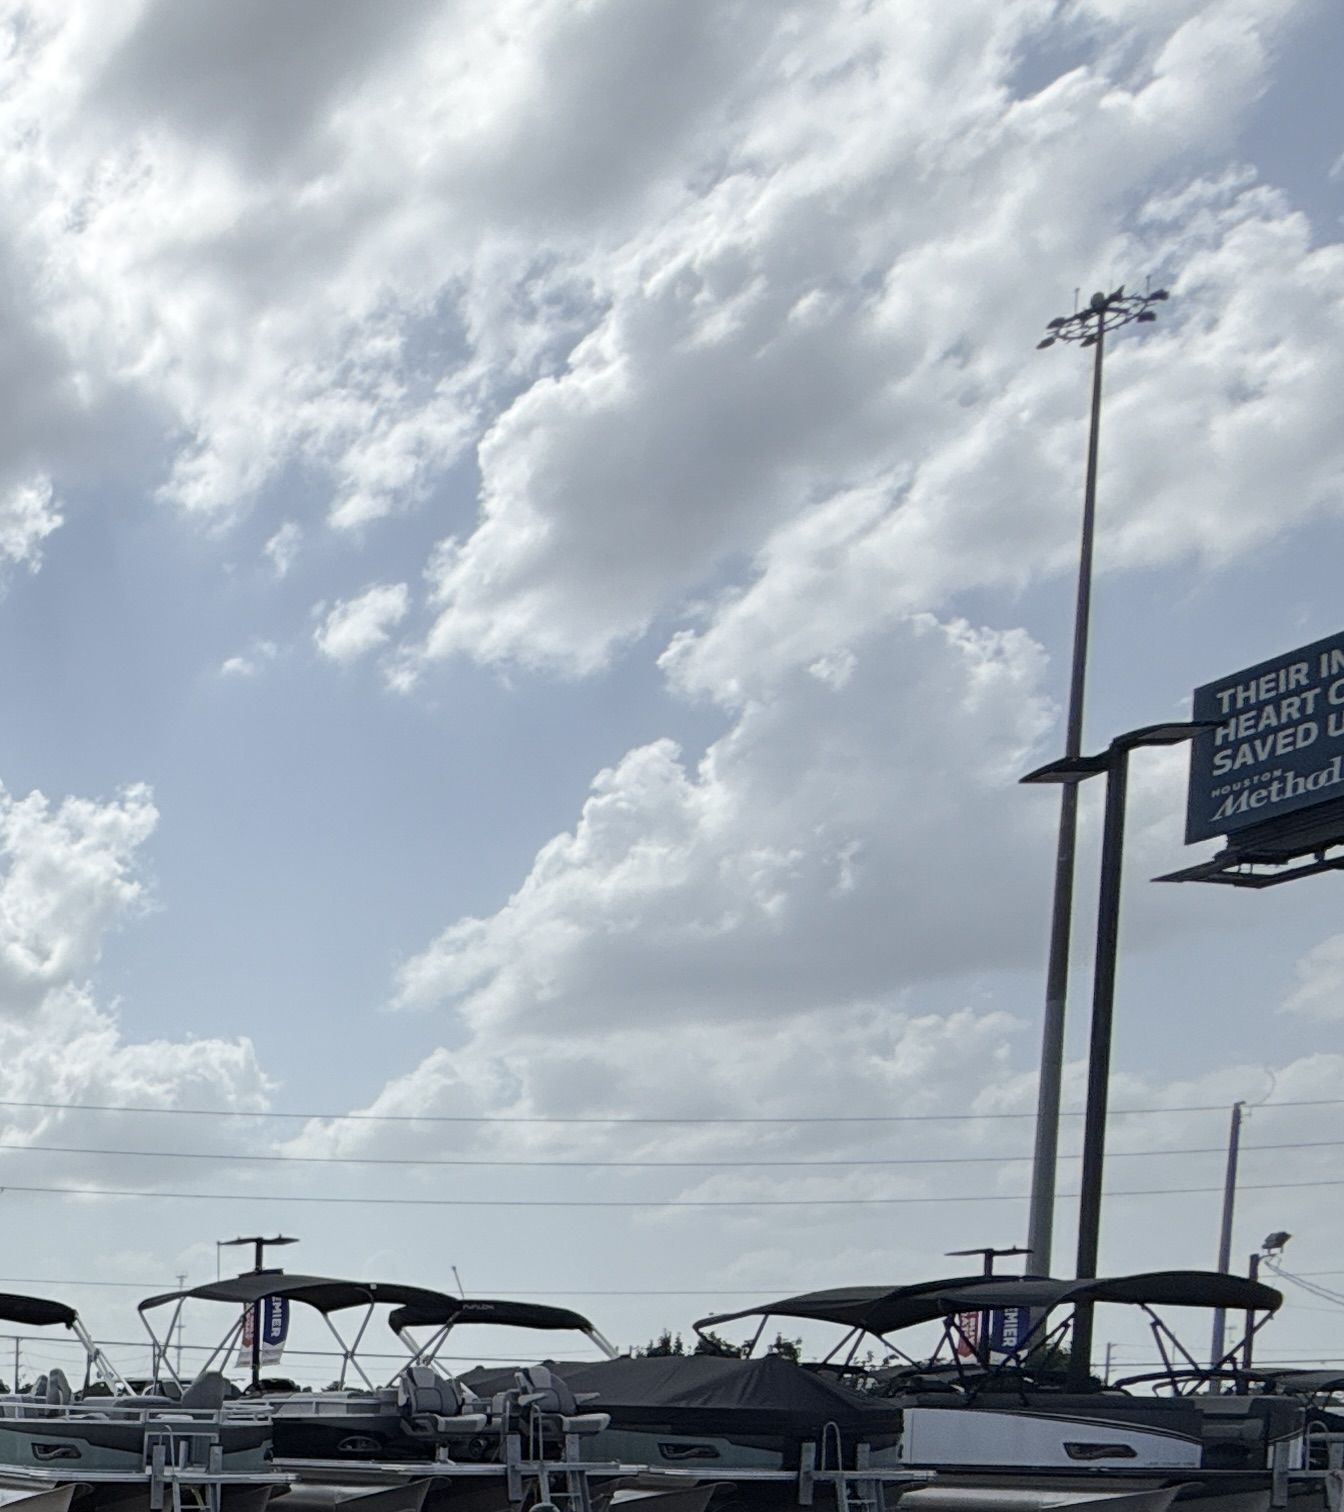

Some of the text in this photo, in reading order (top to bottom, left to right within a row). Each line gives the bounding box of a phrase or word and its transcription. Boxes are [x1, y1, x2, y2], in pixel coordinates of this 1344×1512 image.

[1216, 662, 1309, 715] THEIR
[1214, 687, 1321, 747] HEART
[1213, 721, 1318, 777] SAVED
[1212, 768, 1283, 798] HOUSTON
